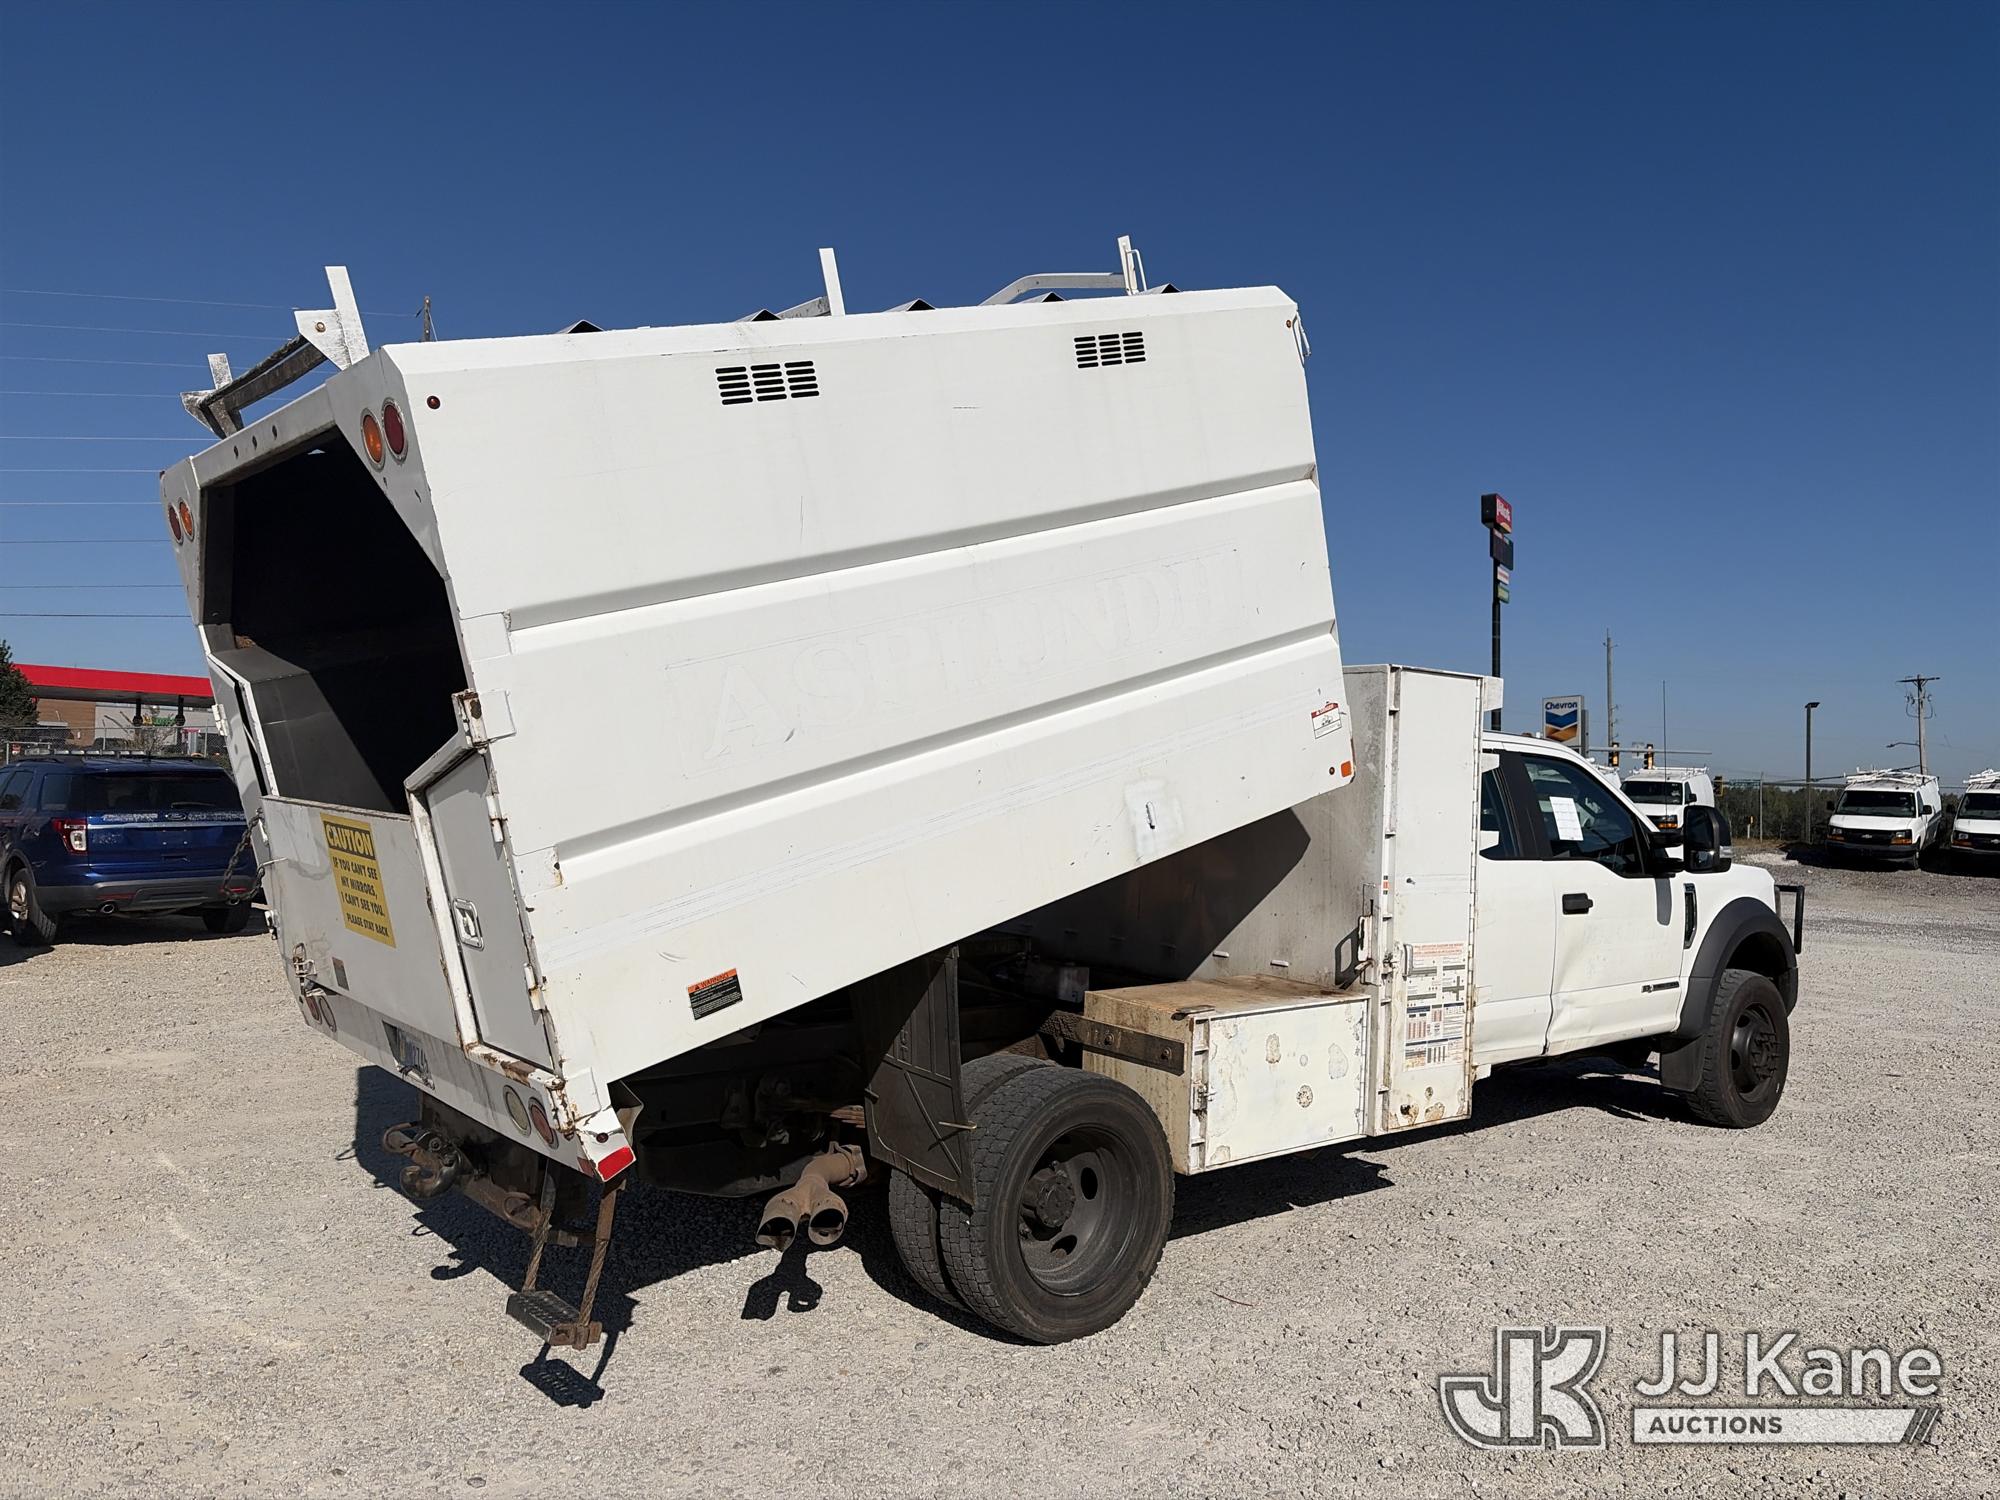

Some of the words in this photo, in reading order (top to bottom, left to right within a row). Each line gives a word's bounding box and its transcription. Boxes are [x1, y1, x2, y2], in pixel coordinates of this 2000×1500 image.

[1545, 701, 1578, 710] Chevron
[325, 823, 374, 857] CAUTION
[338, 858, 350, 871] YOU
[367, 866, 378, 880] SEE
[360, 898, 370, 911] SEE
